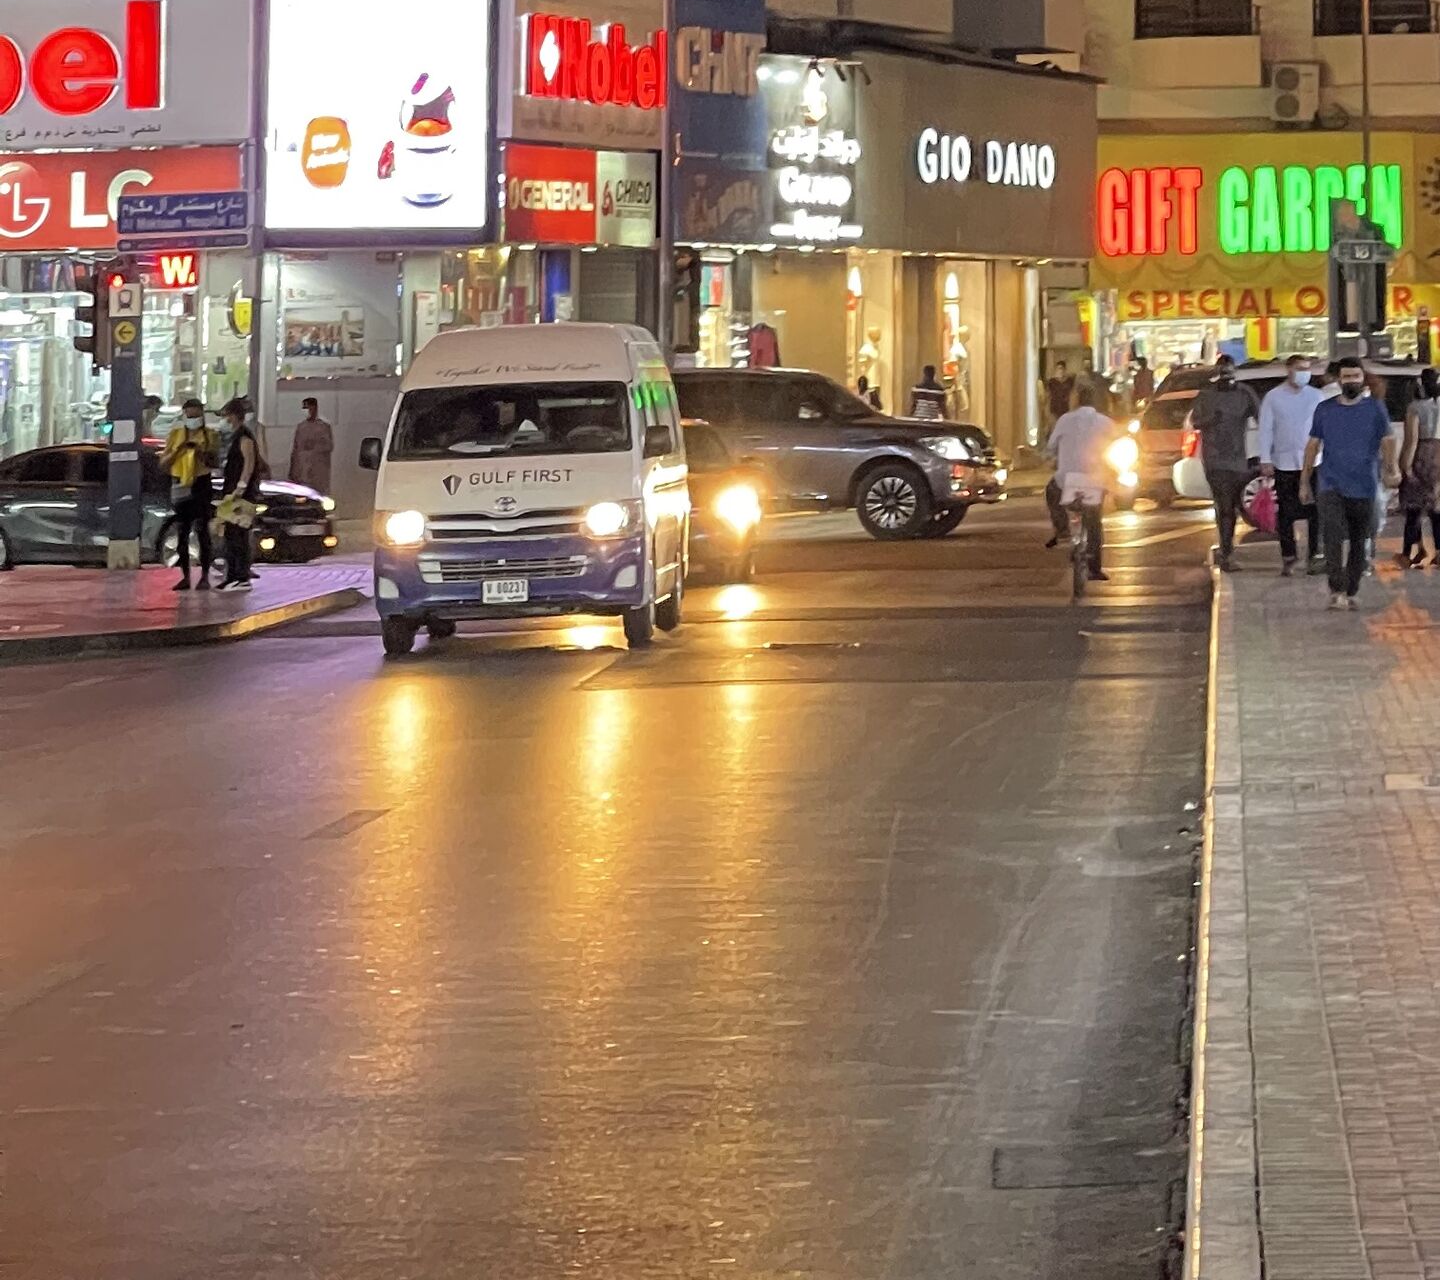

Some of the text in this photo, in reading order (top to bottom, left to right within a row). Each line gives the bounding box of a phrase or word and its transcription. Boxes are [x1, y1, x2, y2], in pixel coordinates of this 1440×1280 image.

[917, 127, 1056, 190] GIODANO
[520, 179, 594, 212] GENERAL
[1099, 166, 1202, 256] GIFT
[1127, 288, 1282, 319] SPECIAL
[469, 469, 574, 486] GULF FIRST
